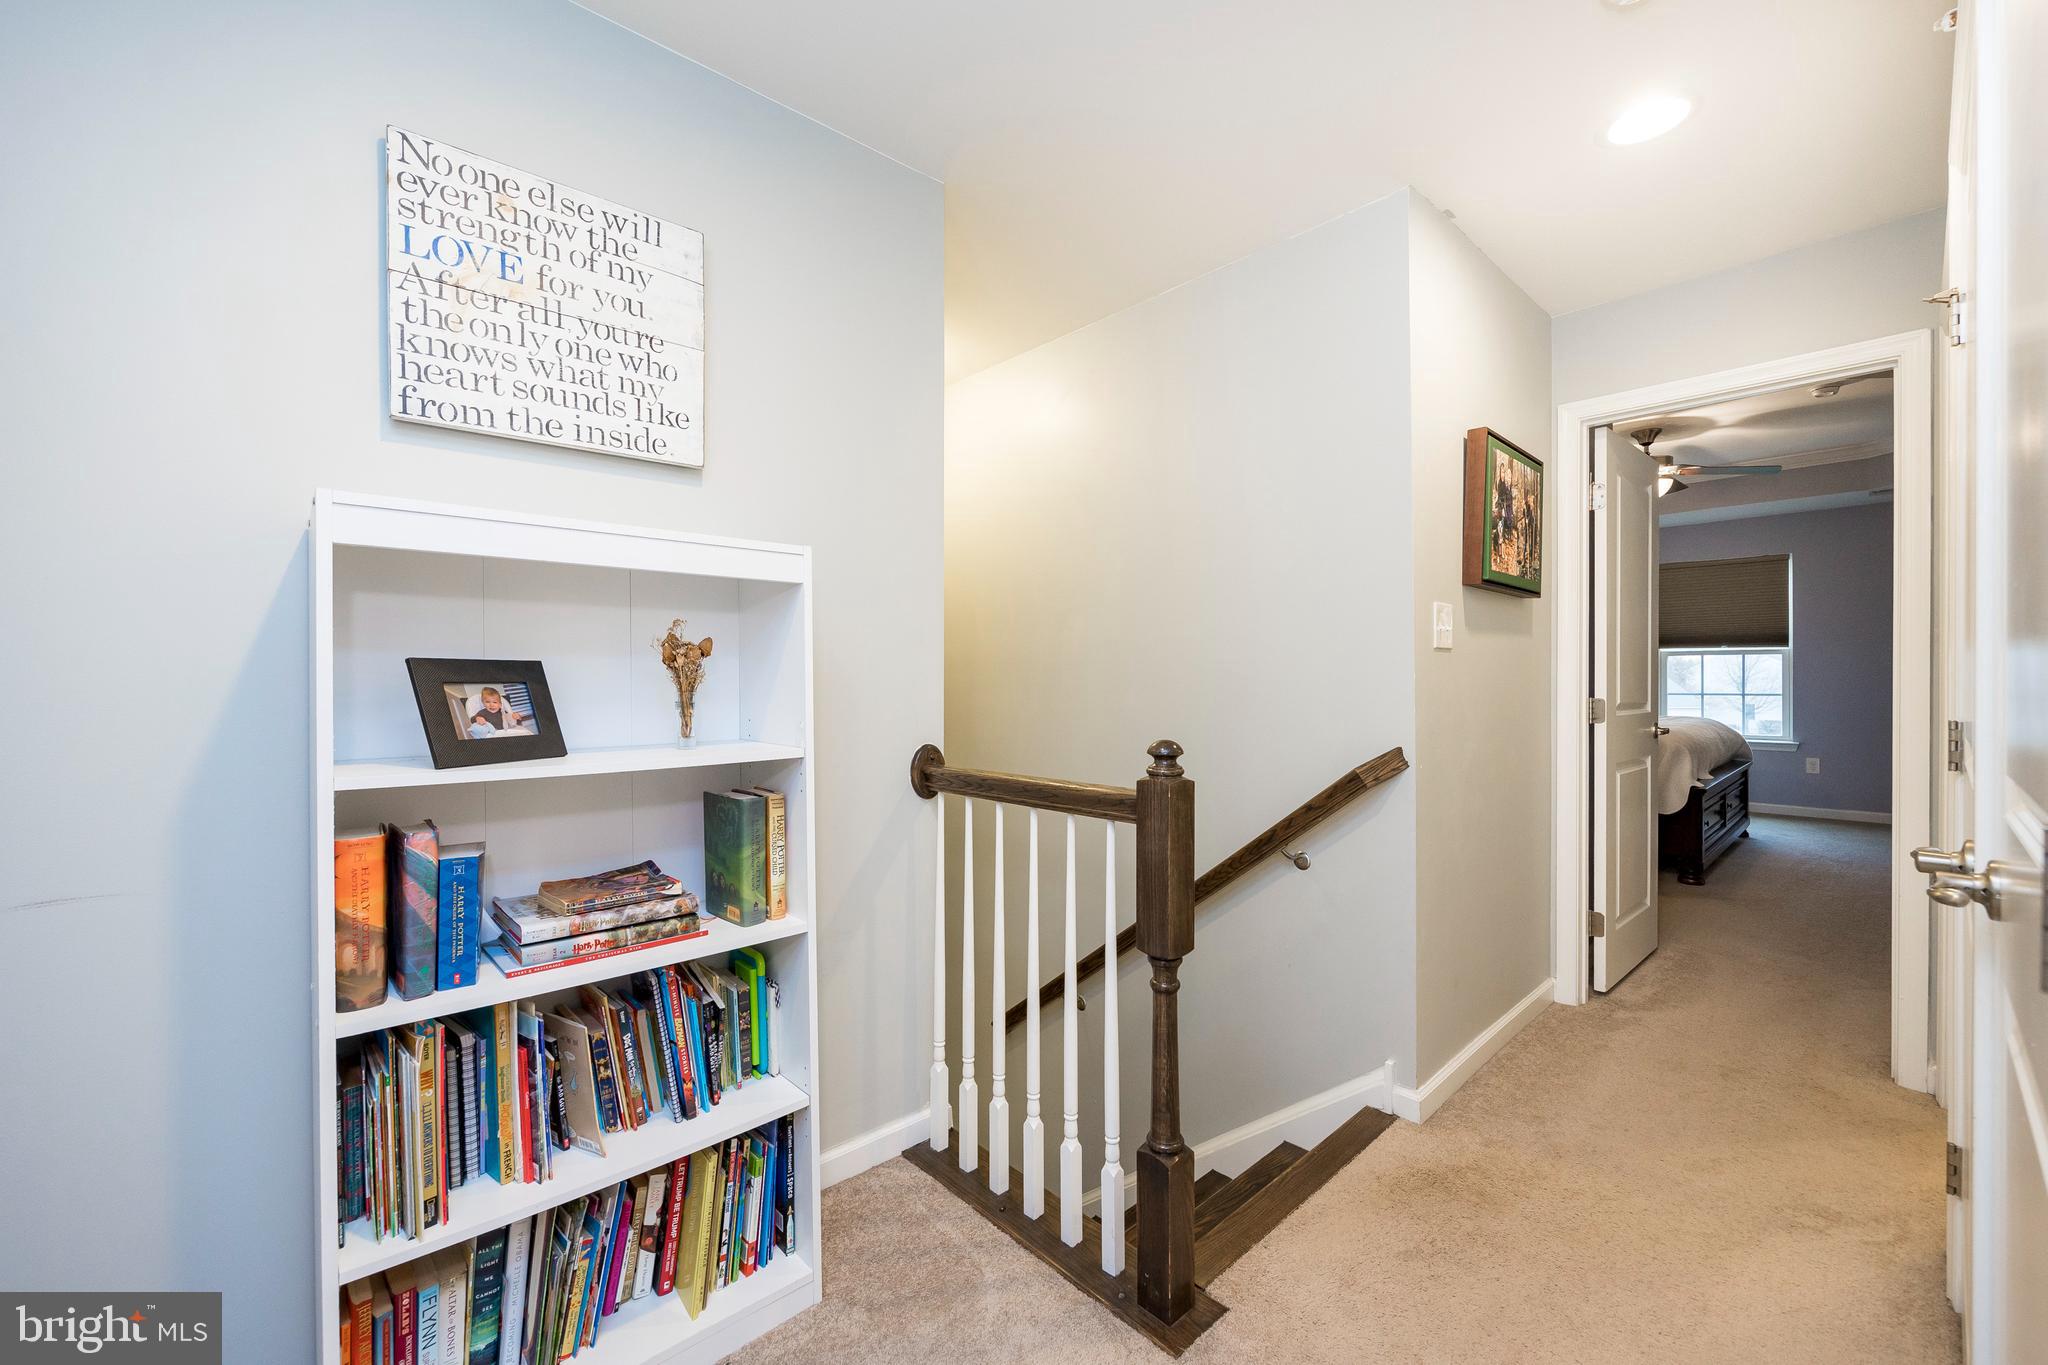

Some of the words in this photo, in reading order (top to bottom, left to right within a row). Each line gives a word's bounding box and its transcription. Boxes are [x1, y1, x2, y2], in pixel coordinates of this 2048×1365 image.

[397, 131, 452, 177] No
[458, 164, 520, 198] one
[528, 182, 594, 223] else
[601, 209, 663, 248] will
[397, 169, 478, 209] ever
[486, 192, 577, 242] know
[588, 226, 638, 262] the
[397, 197, 560, 262] strength
[570, 248, 602, 274] of
[608, 264, 654, 292] my
[396, 262, 507, 315] After
[400, 224, 524, 285] LOVE
[537, 264, 583, 300] for
[592, 286, 654, 320] you.
[401, 295, 463, 333] the
[470, 318, 548, 356] only
[555, 337, 611, 367] one
[617, 352, 678, 382] who
[397, 324, 518, 373] knows
[527, 355, 610, 391] what
[617, 375, 664, 405] my
[398, 353, 505, 397] heart
[513, 383, 626, 418] sounds
[634, 397, 690, 430] like
[398, 384, 496, 430] from
[507, 407, 563, 438] the
[574, 415, 674, 456] inside.
[776, 814, 785, 844] HARRY
[777, 844, 785, 877] POTTER
[361, 867, 371, 913] HARRY
[361, 917, 371, 962] POTTER
[572, 941, 594, 955] Harry
[594, 939, 617, 951] Potter
[671, 985, 679, 1016] 5-MINUTE
[622, 1033, 631, 1049] DOG
[674, 1018, 685, 1048] BATMAN
[680, 1048, 689, 1074] STORIES
[503, 1150, 511, 1179] FRENCH
[678, 1163, 686, 1176] LET
[675, 1176, 685, 1202] TRUMP
[674, 1202, 681, 1212] BE
[670, 1213, 679, 1238] TRUMP
[516, 1231, 524, 1262] OBAMA
[480, 1259, 499, 1269] LIGHT
[475, 1287, 500, 1299] CANNOT
[512, 1266, 522, 1306] MICHELLE
[401, 1292, 410, 1335] ZOLAR'S
[447, 1290, 456, 1318] ALTAR
[358, 1303, 372, 1339] JEFFREY
[422, 1295, 438, 1351] FLYNN
[447, 1326, 456, 1357] BONES
[506, 1318, 516, 1363] BECOMING
